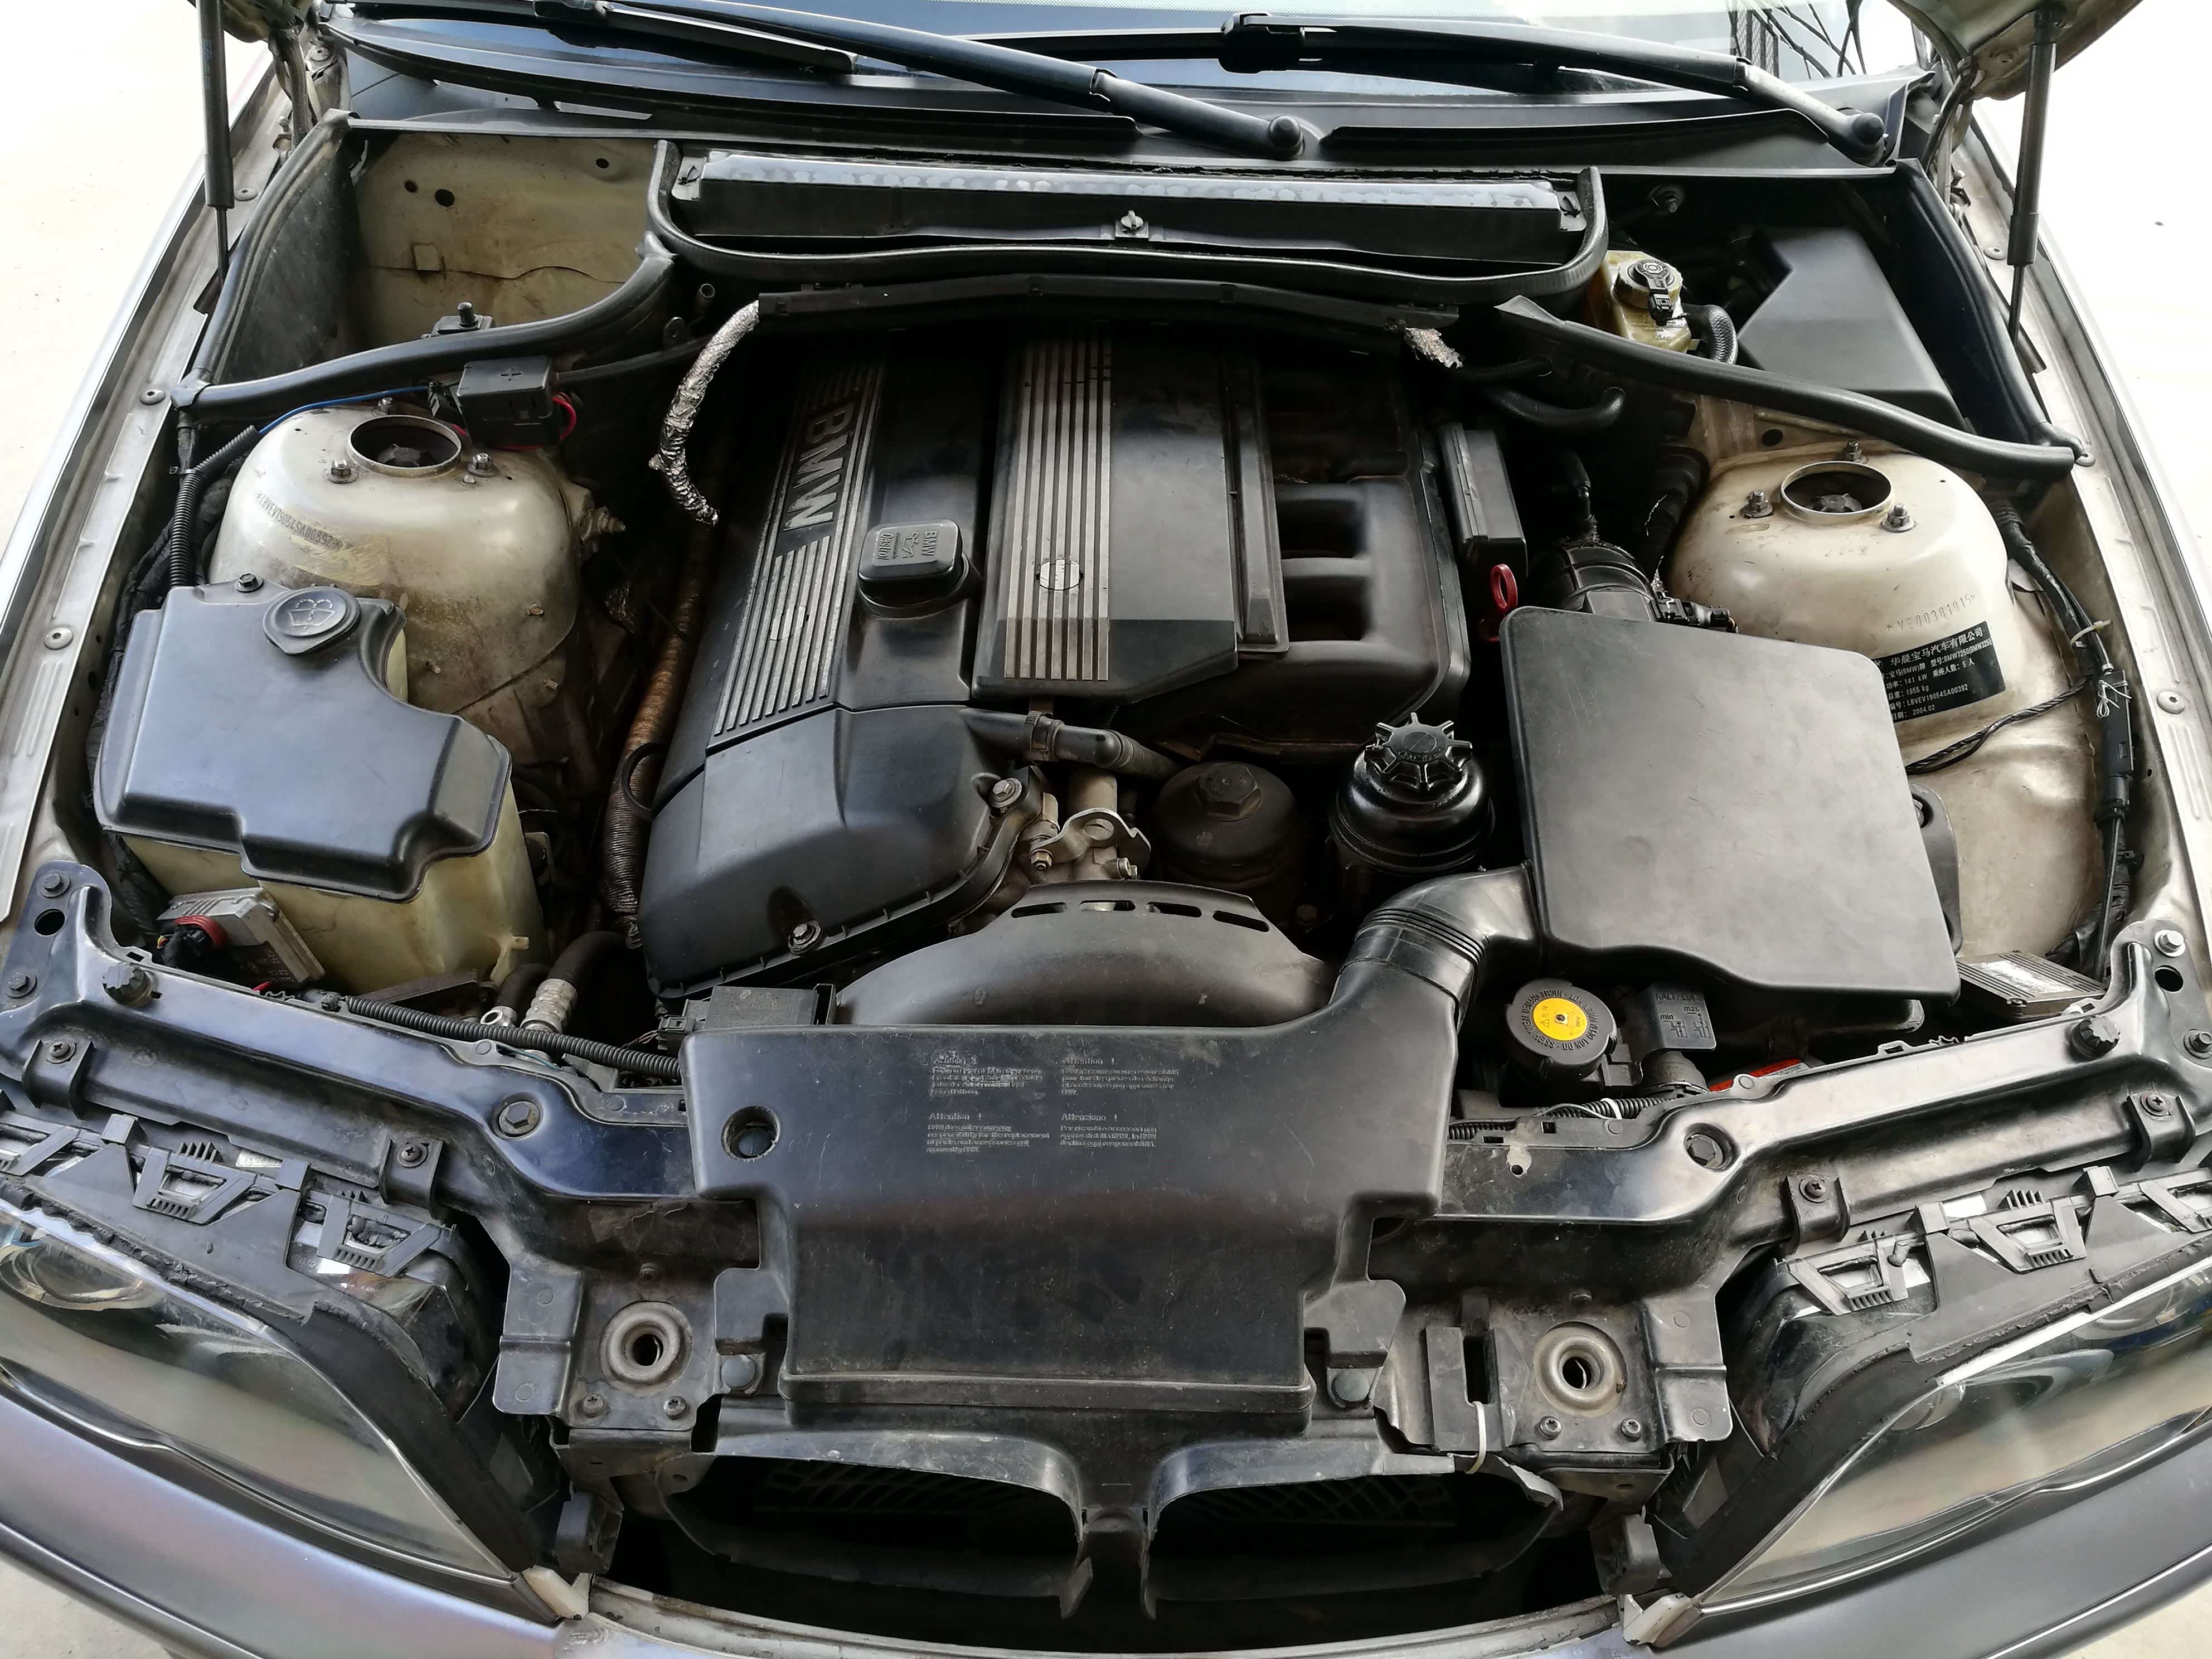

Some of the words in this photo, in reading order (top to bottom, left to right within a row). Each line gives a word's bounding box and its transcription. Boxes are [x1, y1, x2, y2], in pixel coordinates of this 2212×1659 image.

[783, 402, 855, 532] BMW
[877, 532, 893, 560] Castrol
[921, 531, 938, 557] BMW
[1890, 627, 1983, 666] 华晨宝马汽车有限公司
[1968, 658, 1975, 667] 人
[1906, 686, 1920, 695] 1955
[1907, 683, 1968, 706] LBVEV19054SA00392
[1912, 704, 1936, 716] 2004.02
[1568, 992, 1585, 1006] HOT
[1585, 1023, 1599, 1040] OPEN
[1562, 1042, 1575, 1050] DO
[1573, 1036, 1592, 1049] NOT
